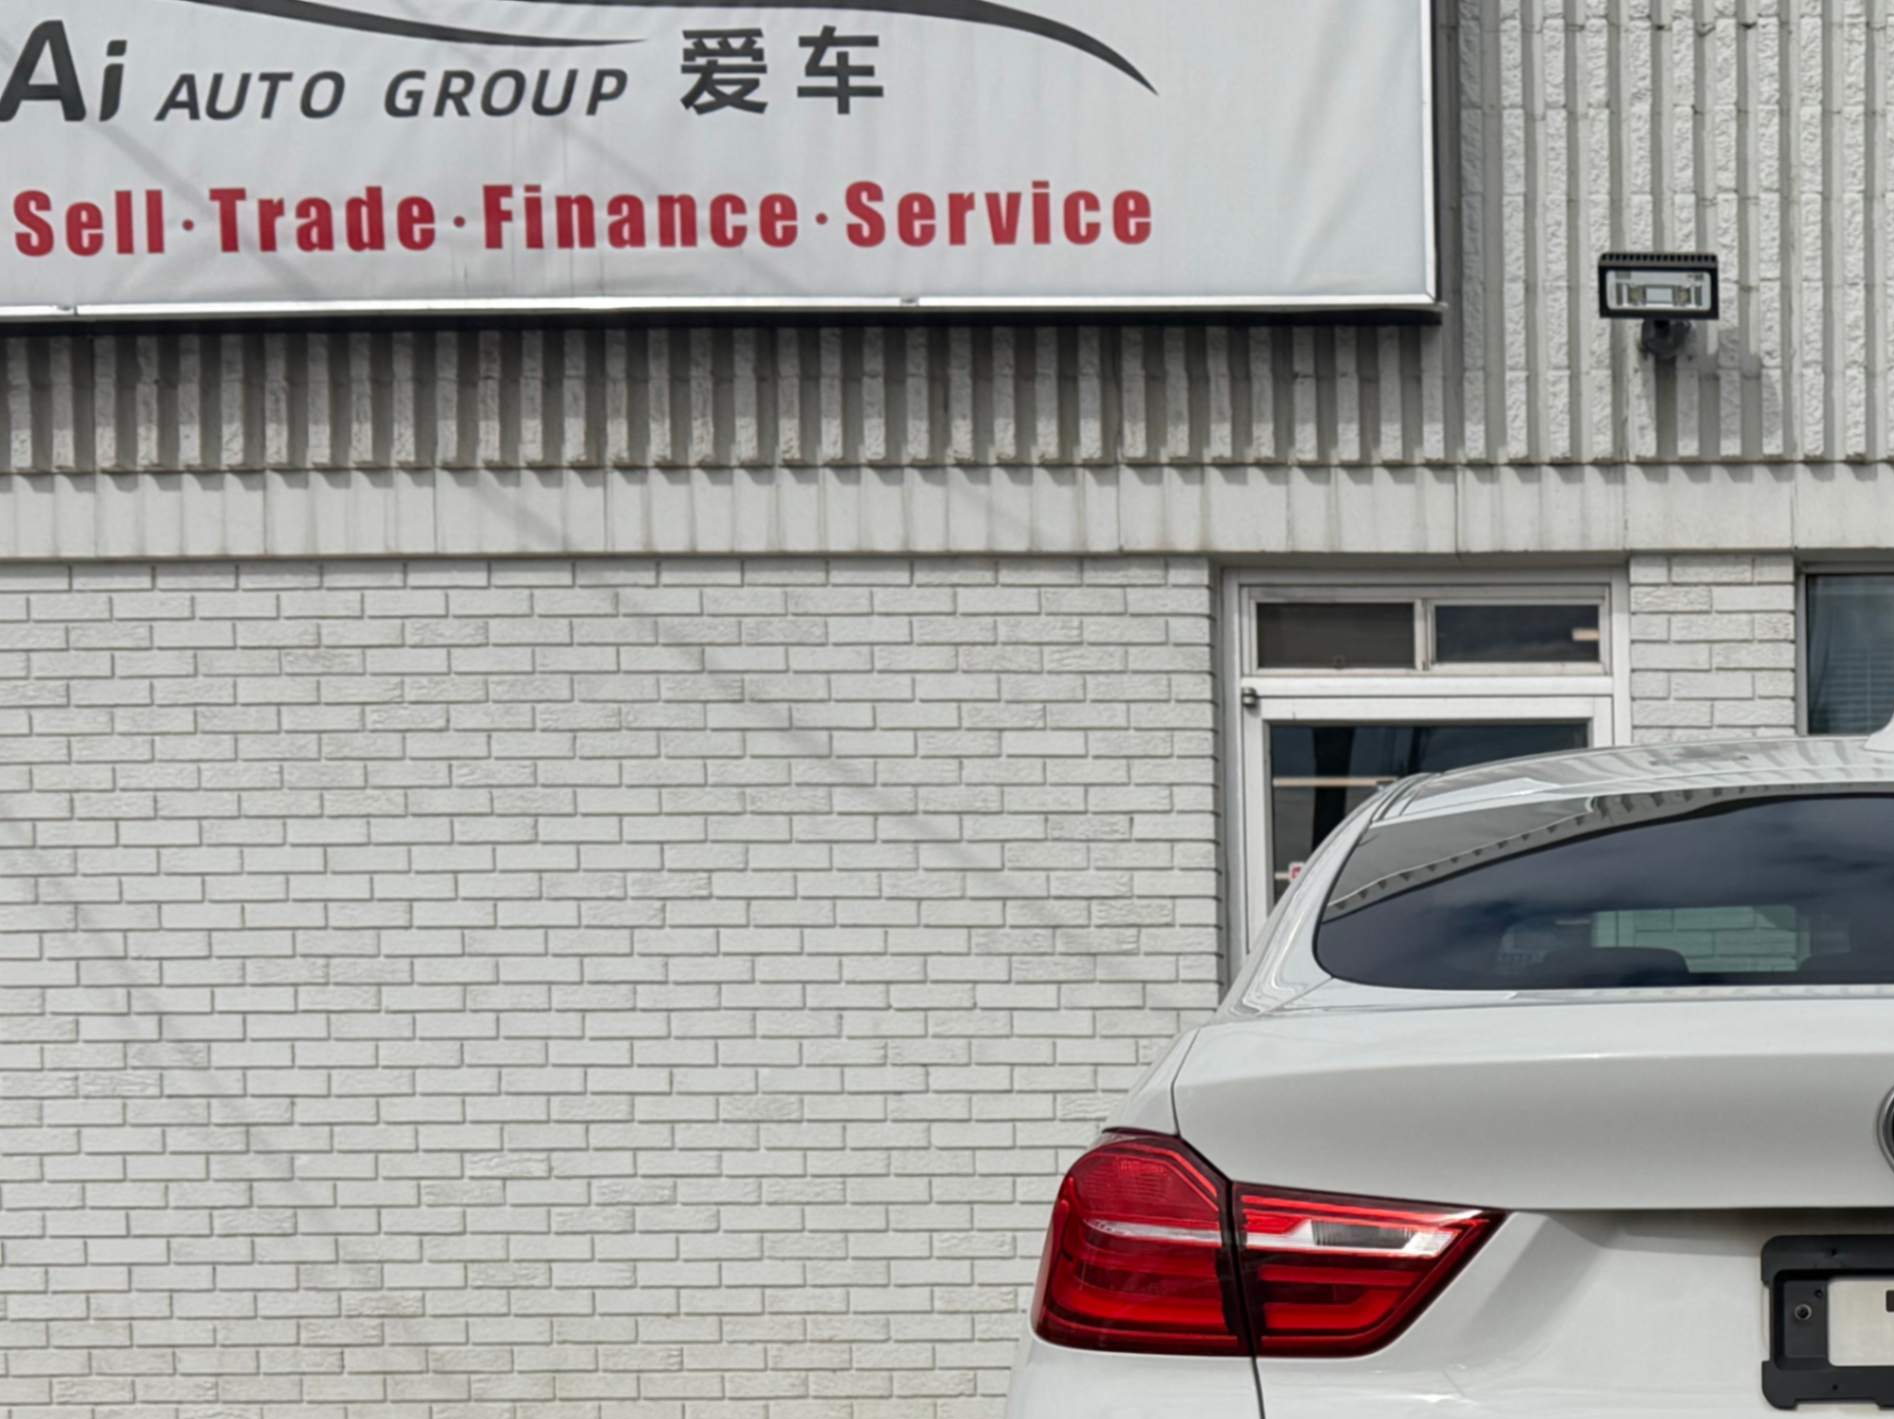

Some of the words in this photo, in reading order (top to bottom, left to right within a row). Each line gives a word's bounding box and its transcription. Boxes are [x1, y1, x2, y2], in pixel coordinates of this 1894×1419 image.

[0, 19, 127, 122] Ai
[154, 71, 345, 121] AUTO
[384, 68, 628, 118] GROUP
[680, 26, 884, 116] 爱车
[14, 189, 164, 257] Sell
[210, 186, 436, 254] Trade
[482, 184, 798, 250] Finance
[846, 181, 1152, 248] Service
